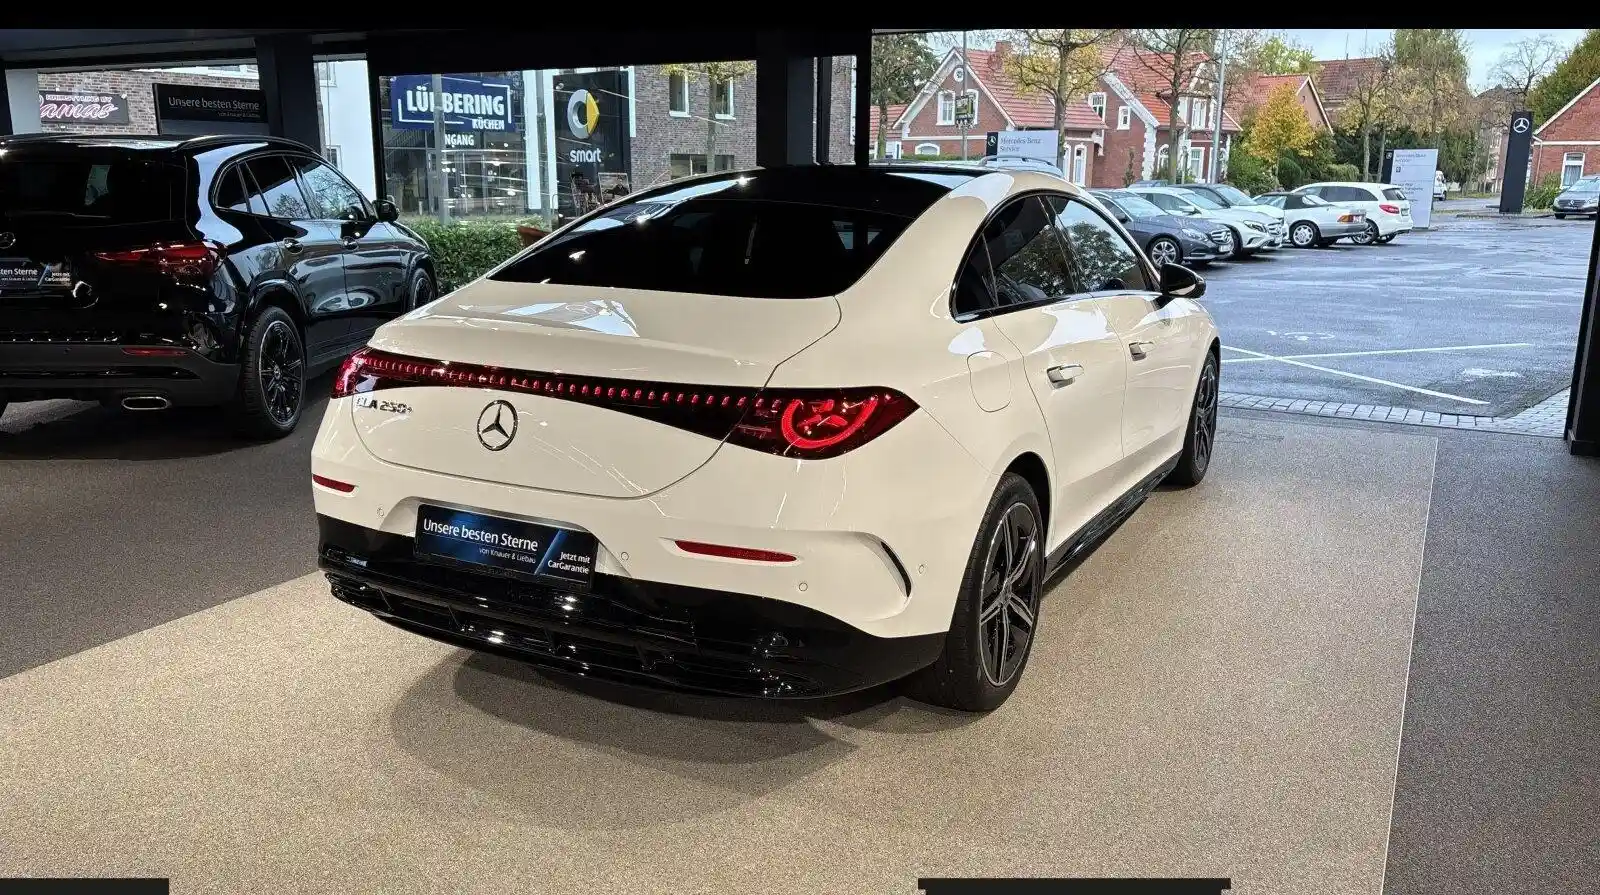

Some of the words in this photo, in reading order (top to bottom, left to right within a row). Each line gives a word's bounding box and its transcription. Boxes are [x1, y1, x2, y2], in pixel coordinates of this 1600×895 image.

[39, 94, 119, 119] amas
[168, 96, 201, 108] Unsere
[201, 97, 232, 109] besten
[232, 100, 260, 110] Sterne
[471, 117, 505, 130] KÜCHEN
[444, 133, 475, 146] NGANG
[569, 148, 602, 163] smart
[14, 268, 38, 276] Sterne
[423, 518, 460, 537] Unsere
[461, 524, 499, 544] besten
[500, 533, 539, 552] Sterne
[479, 548, 490, 556] von
[490, 549, 511, 560] Knauer
[516, 552, 537, 564] Liebau
[559, 551, 577, 563] Jetzt
[577, 555, 591, 564] mit
[547, 560, 590, 574] CarGarantie
